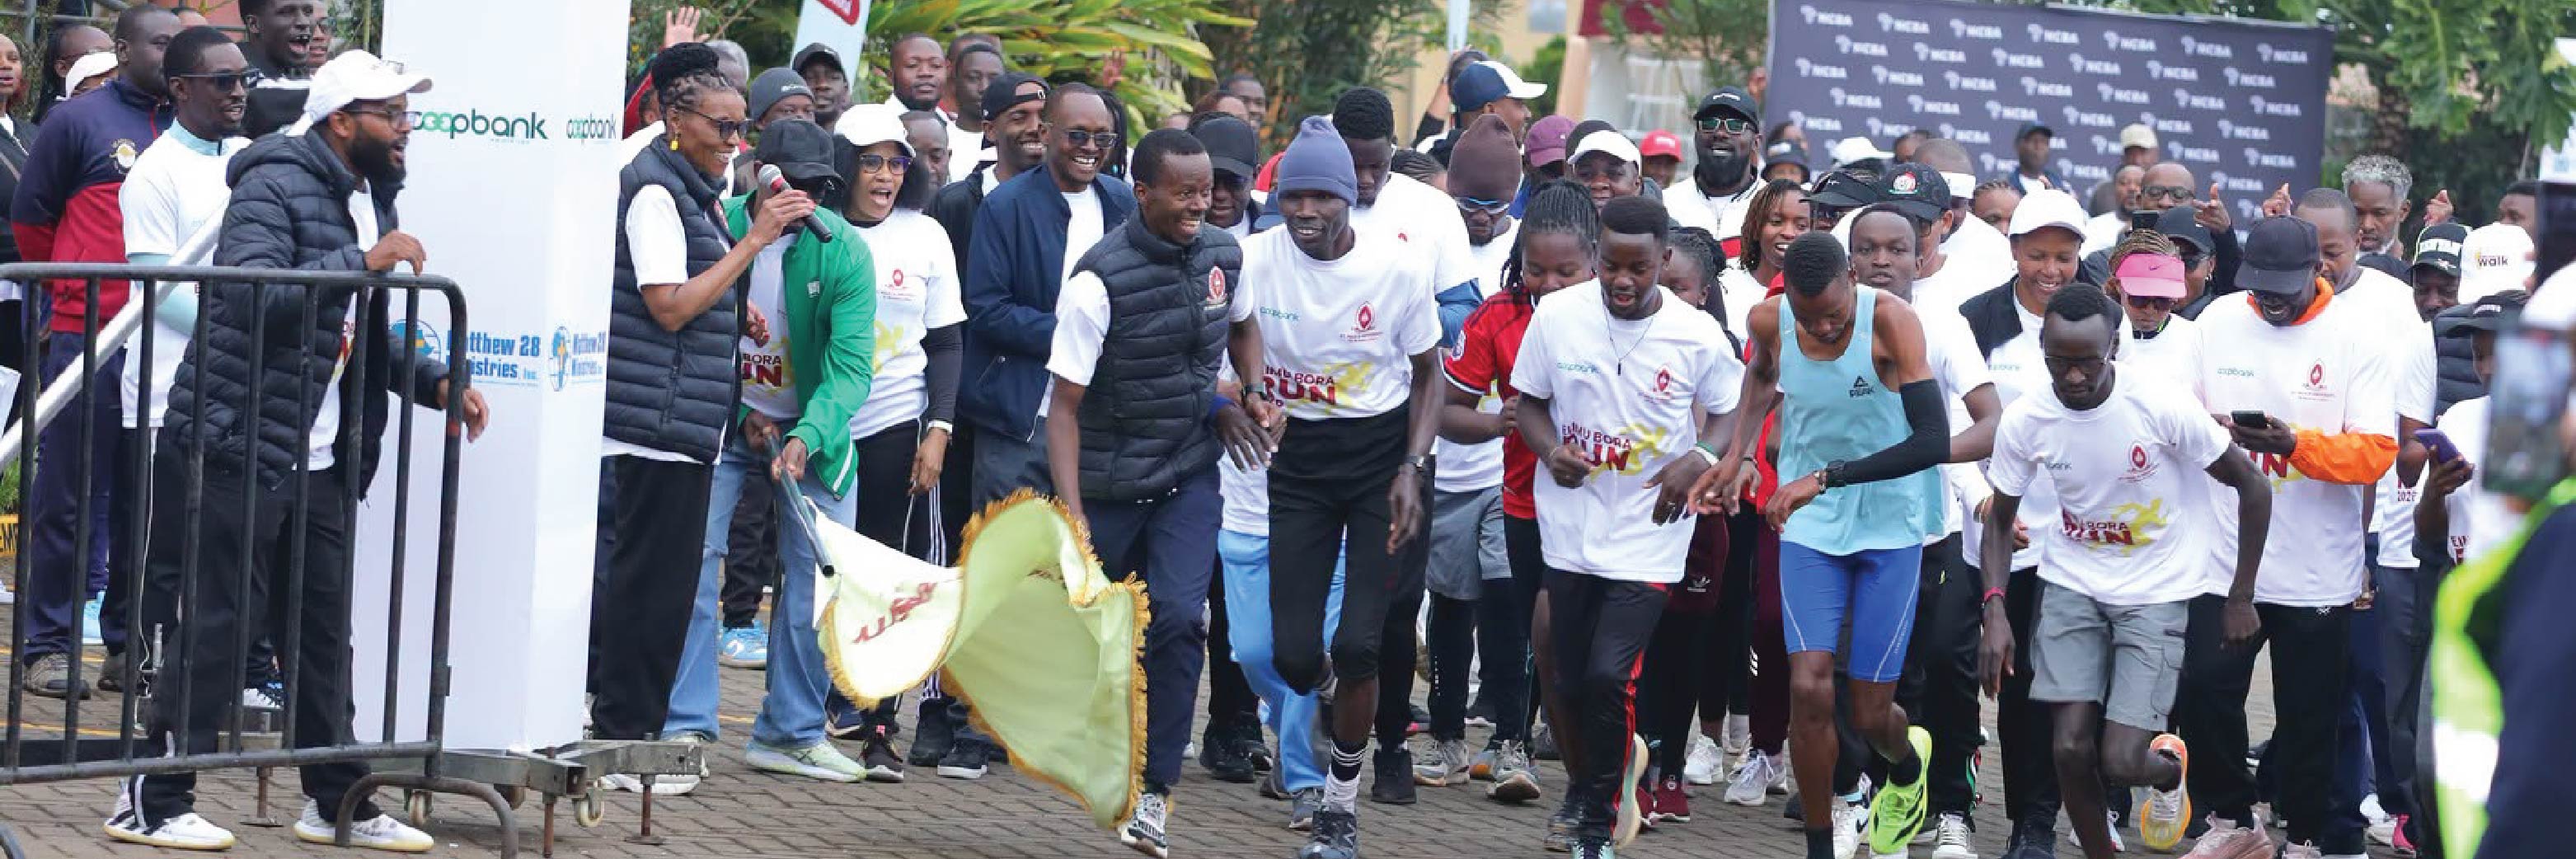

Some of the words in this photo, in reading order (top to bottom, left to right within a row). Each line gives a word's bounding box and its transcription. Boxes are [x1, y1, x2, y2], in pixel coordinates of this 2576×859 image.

[1818, 12, 1853, 26] NCBA
[1893, 19, 1930, 34] NCBA
[1967, 24, 2002, 39] NCBA
[2044, 30, 2079, 44] NCBA
[1852, 42, 1888, 56] NCBA
[2120, 38, 2156, 52] NCBA
[2197, 43, 2232, 58] NCBA
[1931, 49, 1966, 63] NCBA
[2009, 53, 2044, 68] NCBA
[2273, 50, 2308, 63] NCBA
[1812, 63, 1847, 78] NCBA
[2086, 59, 2121, 74] NCBA
[2163, 66, 2199, 81] NCBA
[1889, 71, 1925, 87] NCBA
[1961, 77, 1997, 91] NCBA
[2240, 73, 2276, 88] NCBA
[2038, 83, 2072, 96] NCBA
[1846, 94, 1882, 109] NCBA
[2114, 90, 2150, 104] NCBA
[2189, 95, 2226, 110] NCBA
[1925, 101, 1960, 115] NCBA
[2002, 107, 2038, 120] NCBA
[2266, 101, 2302, 116] NCBA
[1806, 117, 1842, 131] NCBA
[2081, 112, 2115, 127] NCBA
[2157, 120, 2193, 134] NCBA
[2233, 126, 2269, 140] NCBA
[1954, 129, 1991, 143] NCBA
[2184, 147, 2220, 162] NCBA
[2261, 153, 2297, 168] NCBA
[2073, 165, 2109, 179] NCBA
[2228, 178, 2264, 191] NCBA
[2479, 254, 2508, 267] walk
[519, 335, 541, 356] 28
